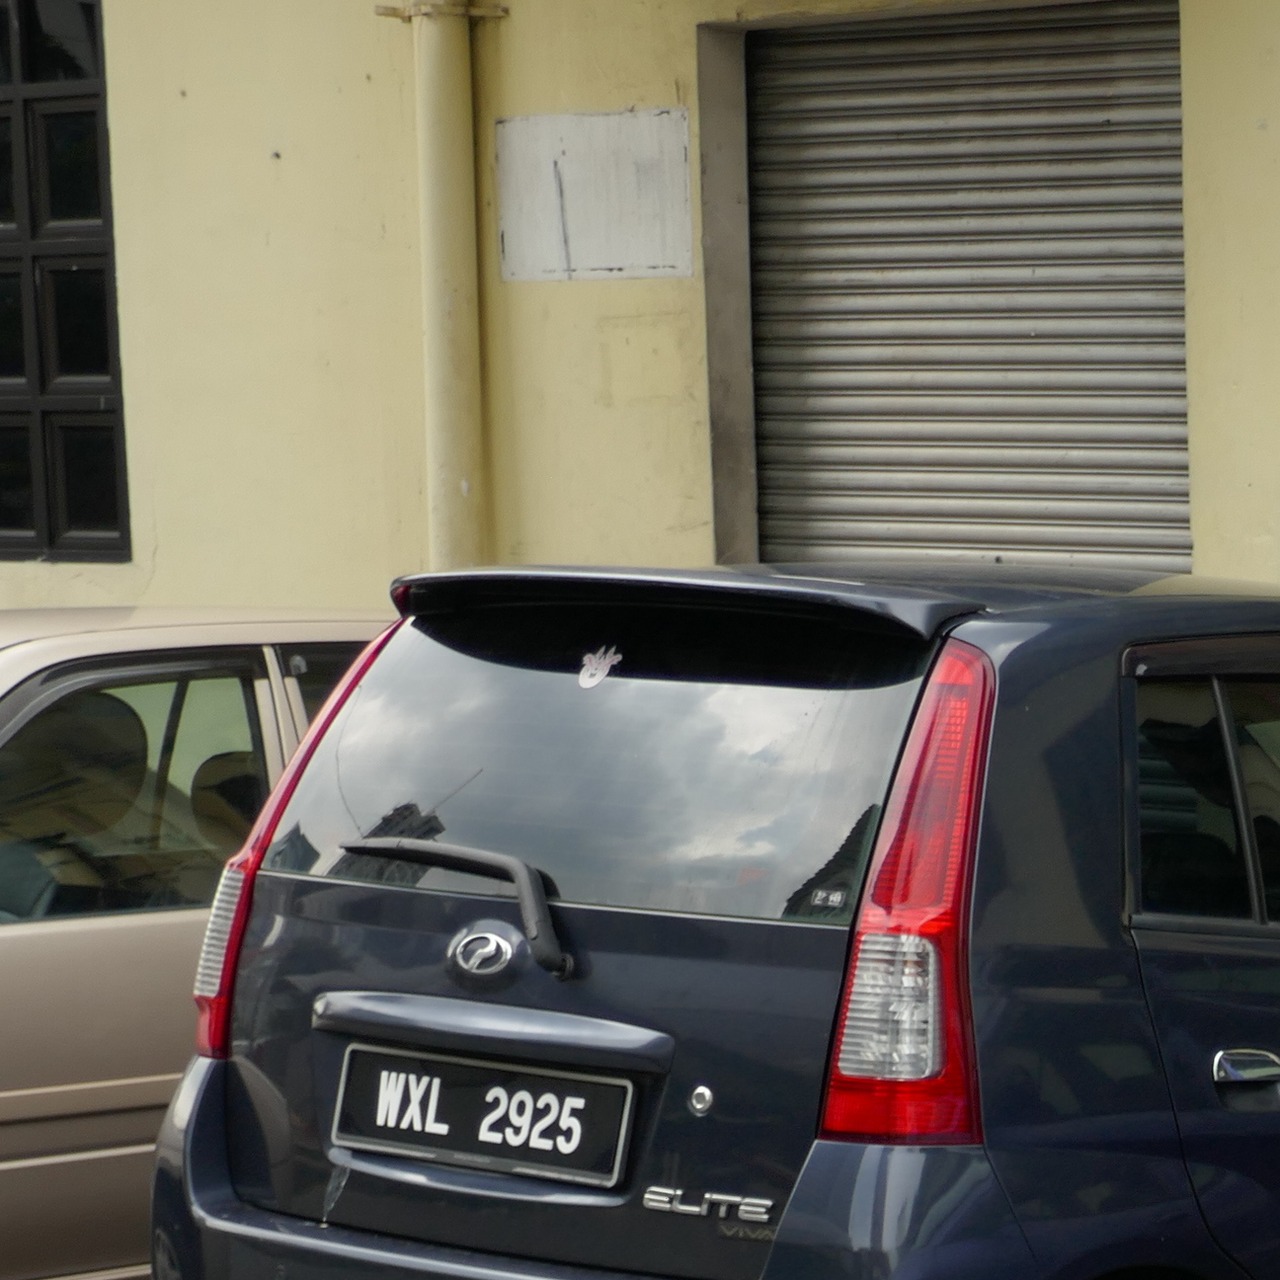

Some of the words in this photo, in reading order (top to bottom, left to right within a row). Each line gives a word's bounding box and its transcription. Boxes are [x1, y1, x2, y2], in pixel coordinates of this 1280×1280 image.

[375, 1070, 449, 1135] WXL
[478, 1086, 586, 1155] 2925
[643, 1185, 774, 1223] ELITE
[719, 1224, 776, 1240] VIVA
